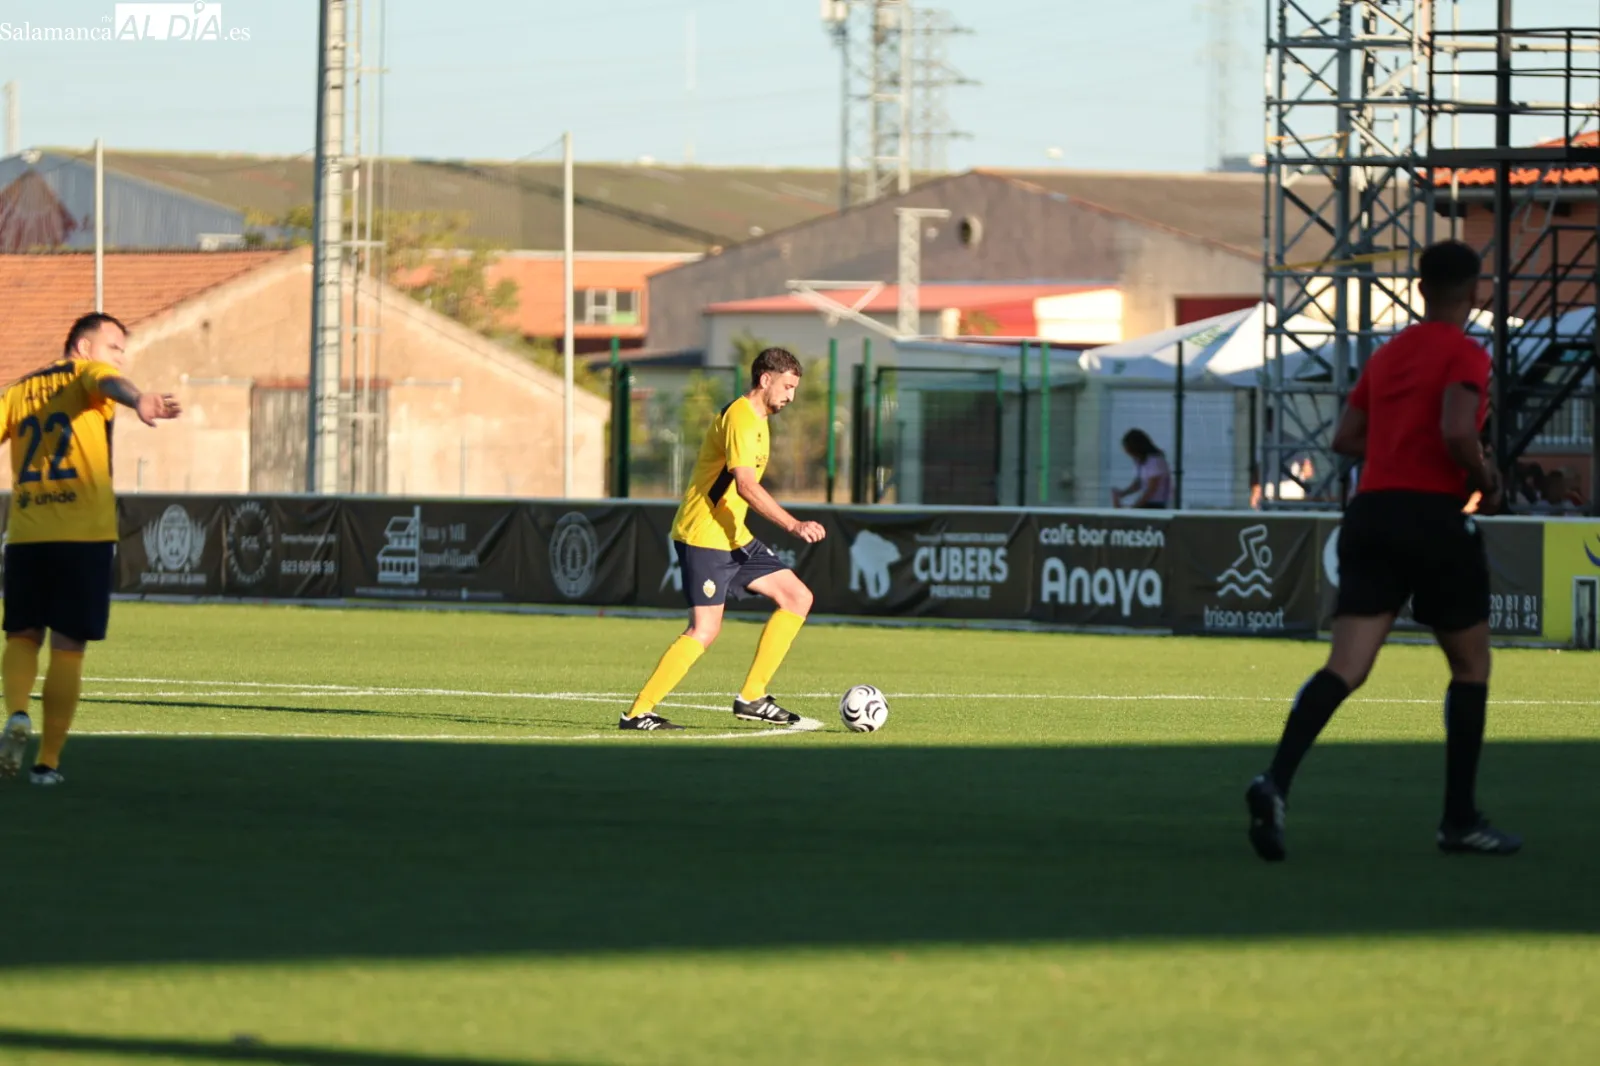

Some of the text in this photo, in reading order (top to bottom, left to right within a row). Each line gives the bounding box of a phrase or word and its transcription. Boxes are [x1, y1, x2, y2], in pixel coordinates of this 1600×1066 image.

[18, 412, 78, 483] 22
[35, 491, 76, 505] unide
[1078, 524, 1106, 546] bar
[1110, 526, 1165, 548] mesón
[913, 546, 1008, 583] CUBERS
[1041, 556, 1163, 617] Anaya
[1505, 594, 1519, 611] 81
[1523, 594, 1537, 612] 81
[1247, 607, 1285, 631] sport
